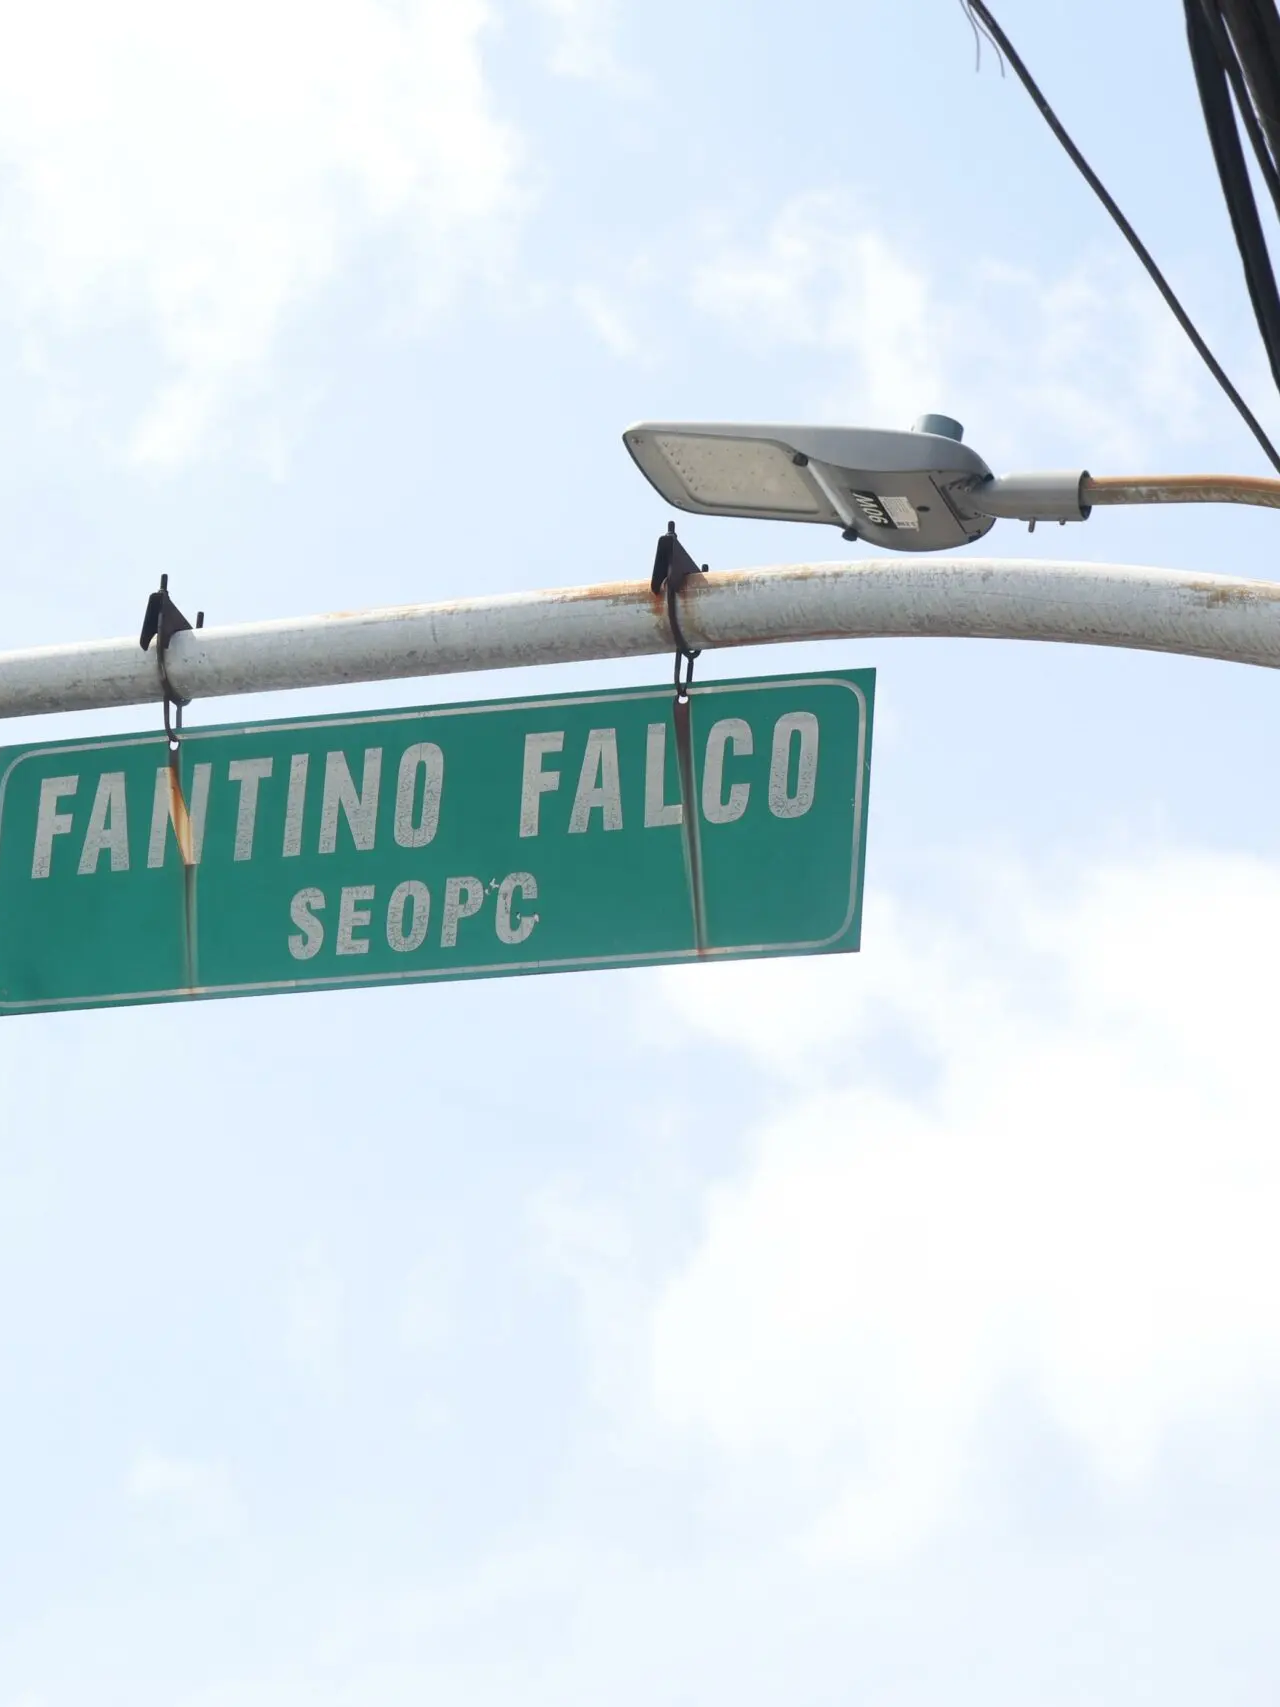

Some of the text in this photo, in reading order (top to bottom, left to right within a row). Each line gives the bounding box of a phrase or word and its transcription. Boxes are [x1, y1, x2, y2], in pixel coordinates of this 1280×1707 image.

[31, 711, 820, 879] FANTINO FALCO
[288, 872, 540, 960] SEOPC
